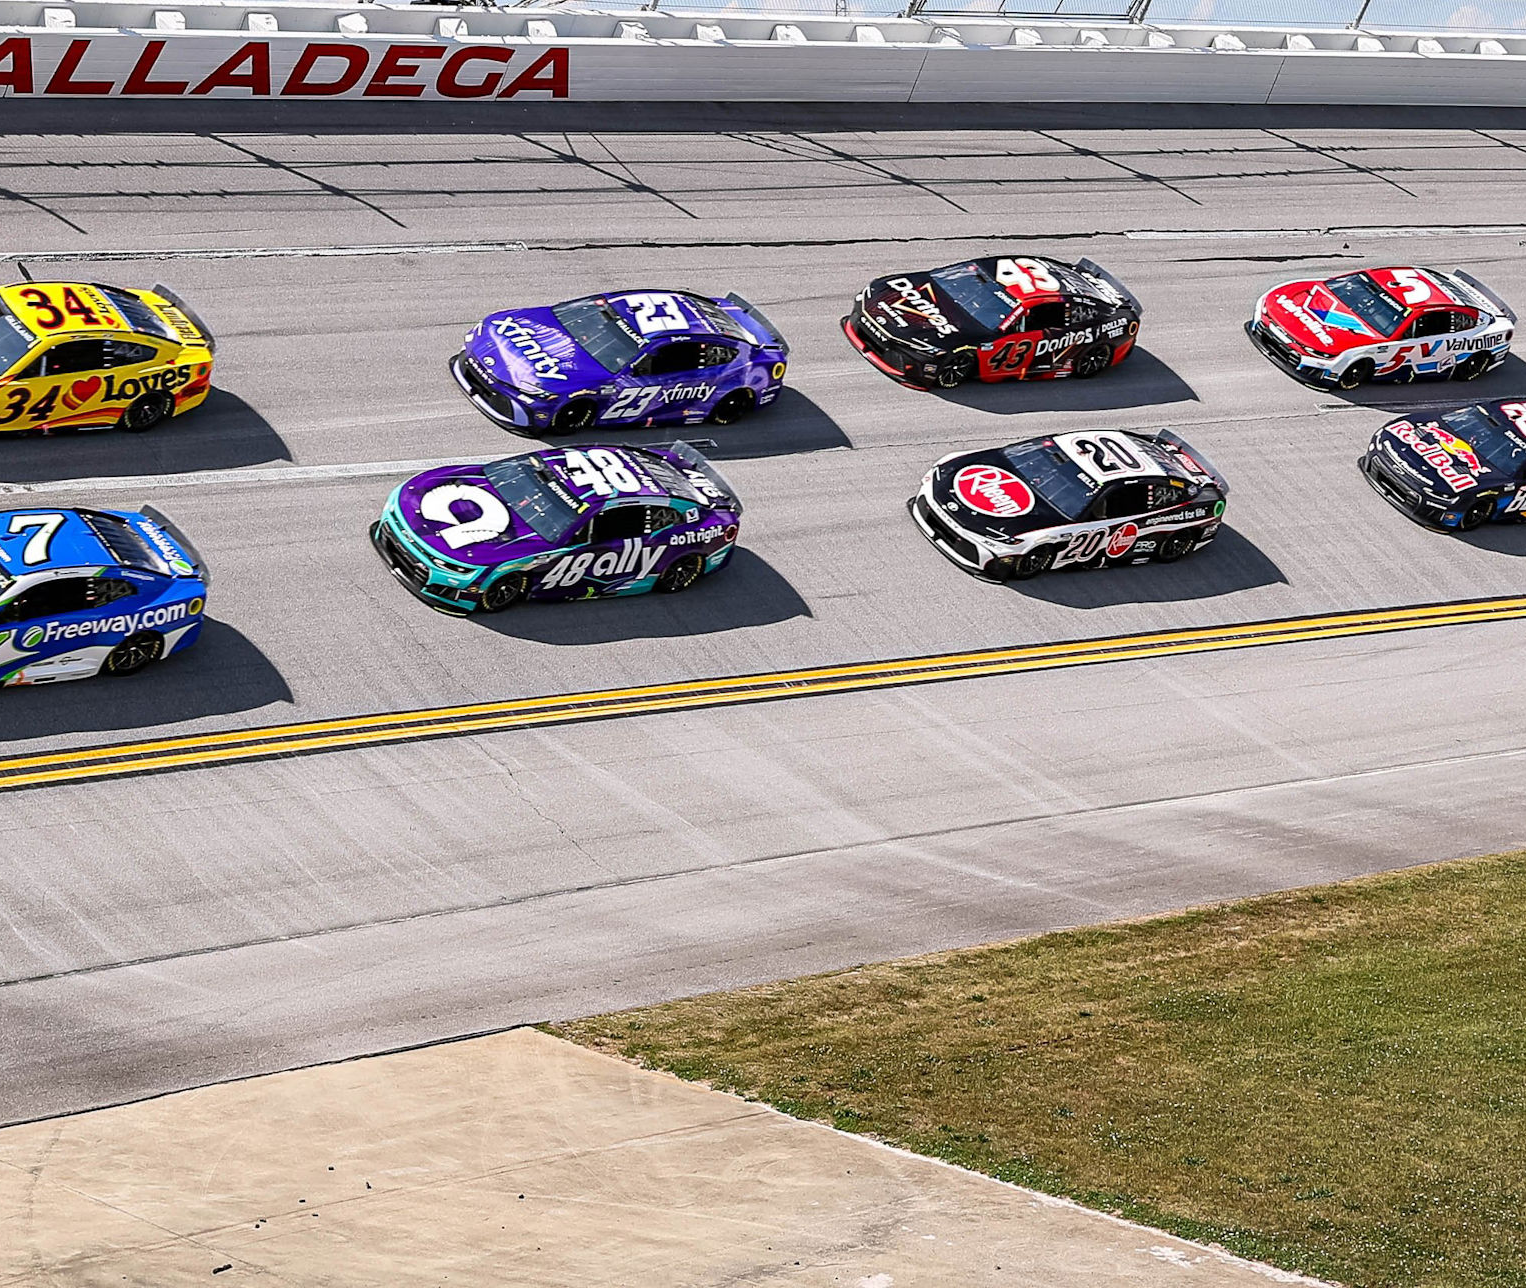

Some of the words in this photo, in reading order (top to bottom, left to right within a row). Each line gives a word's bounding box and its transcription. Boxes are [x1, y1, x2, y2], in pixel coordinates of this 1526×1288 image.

[996, 258, 1061, 294] 43
[1390, 269, 1432, 305] 5
[20, 288, 102, 329] 34
[624, 293, 690, 335] 23
[886, 277, 959, 335] Doritos
[1379, 292, 1404, 312] LARSON
[1101, 318, 1128, 333] DOLLAR
[1107, 327, 1124, 339] TREE
[1276, 294, 1335, 347] Valvoline
[491, 316, 567, 380] xfinity
[988, 339, 1032, 372] 43
[1035, 328, 1094, 356] Doritos
[1446, 333, 1503, 352] Valvoline
[1374, 346, 1415, 376] 5
[600, 386, 662, 420] 23
[658, 382, 716, 404] xfinity
[565, 448, 642, 496] 48
[1075, 437, 1141, 473] 20
[1385, 420, 1442, 456] Red
[1423, 450, 1478, 493] Bull
[547, 480, 579, 510] BOWMAN
[958, 468, 1022, 516] Rheem
[1077, 472, 1096, 489] BELL
[1145, 512, 1184, 526] engineered
[1184, 510, 1195, 519] for
[1195, 508, 1207, 517] life
[9, 514, 66, 565] 7
[1061, 527, 1108, 562] 20
[1134, 541, 1157, 549] PRO
[541, 552, 595, 590] 48
[593, 537, 667, 580] ally
[43, 603, 186, 643] Freeway.com
